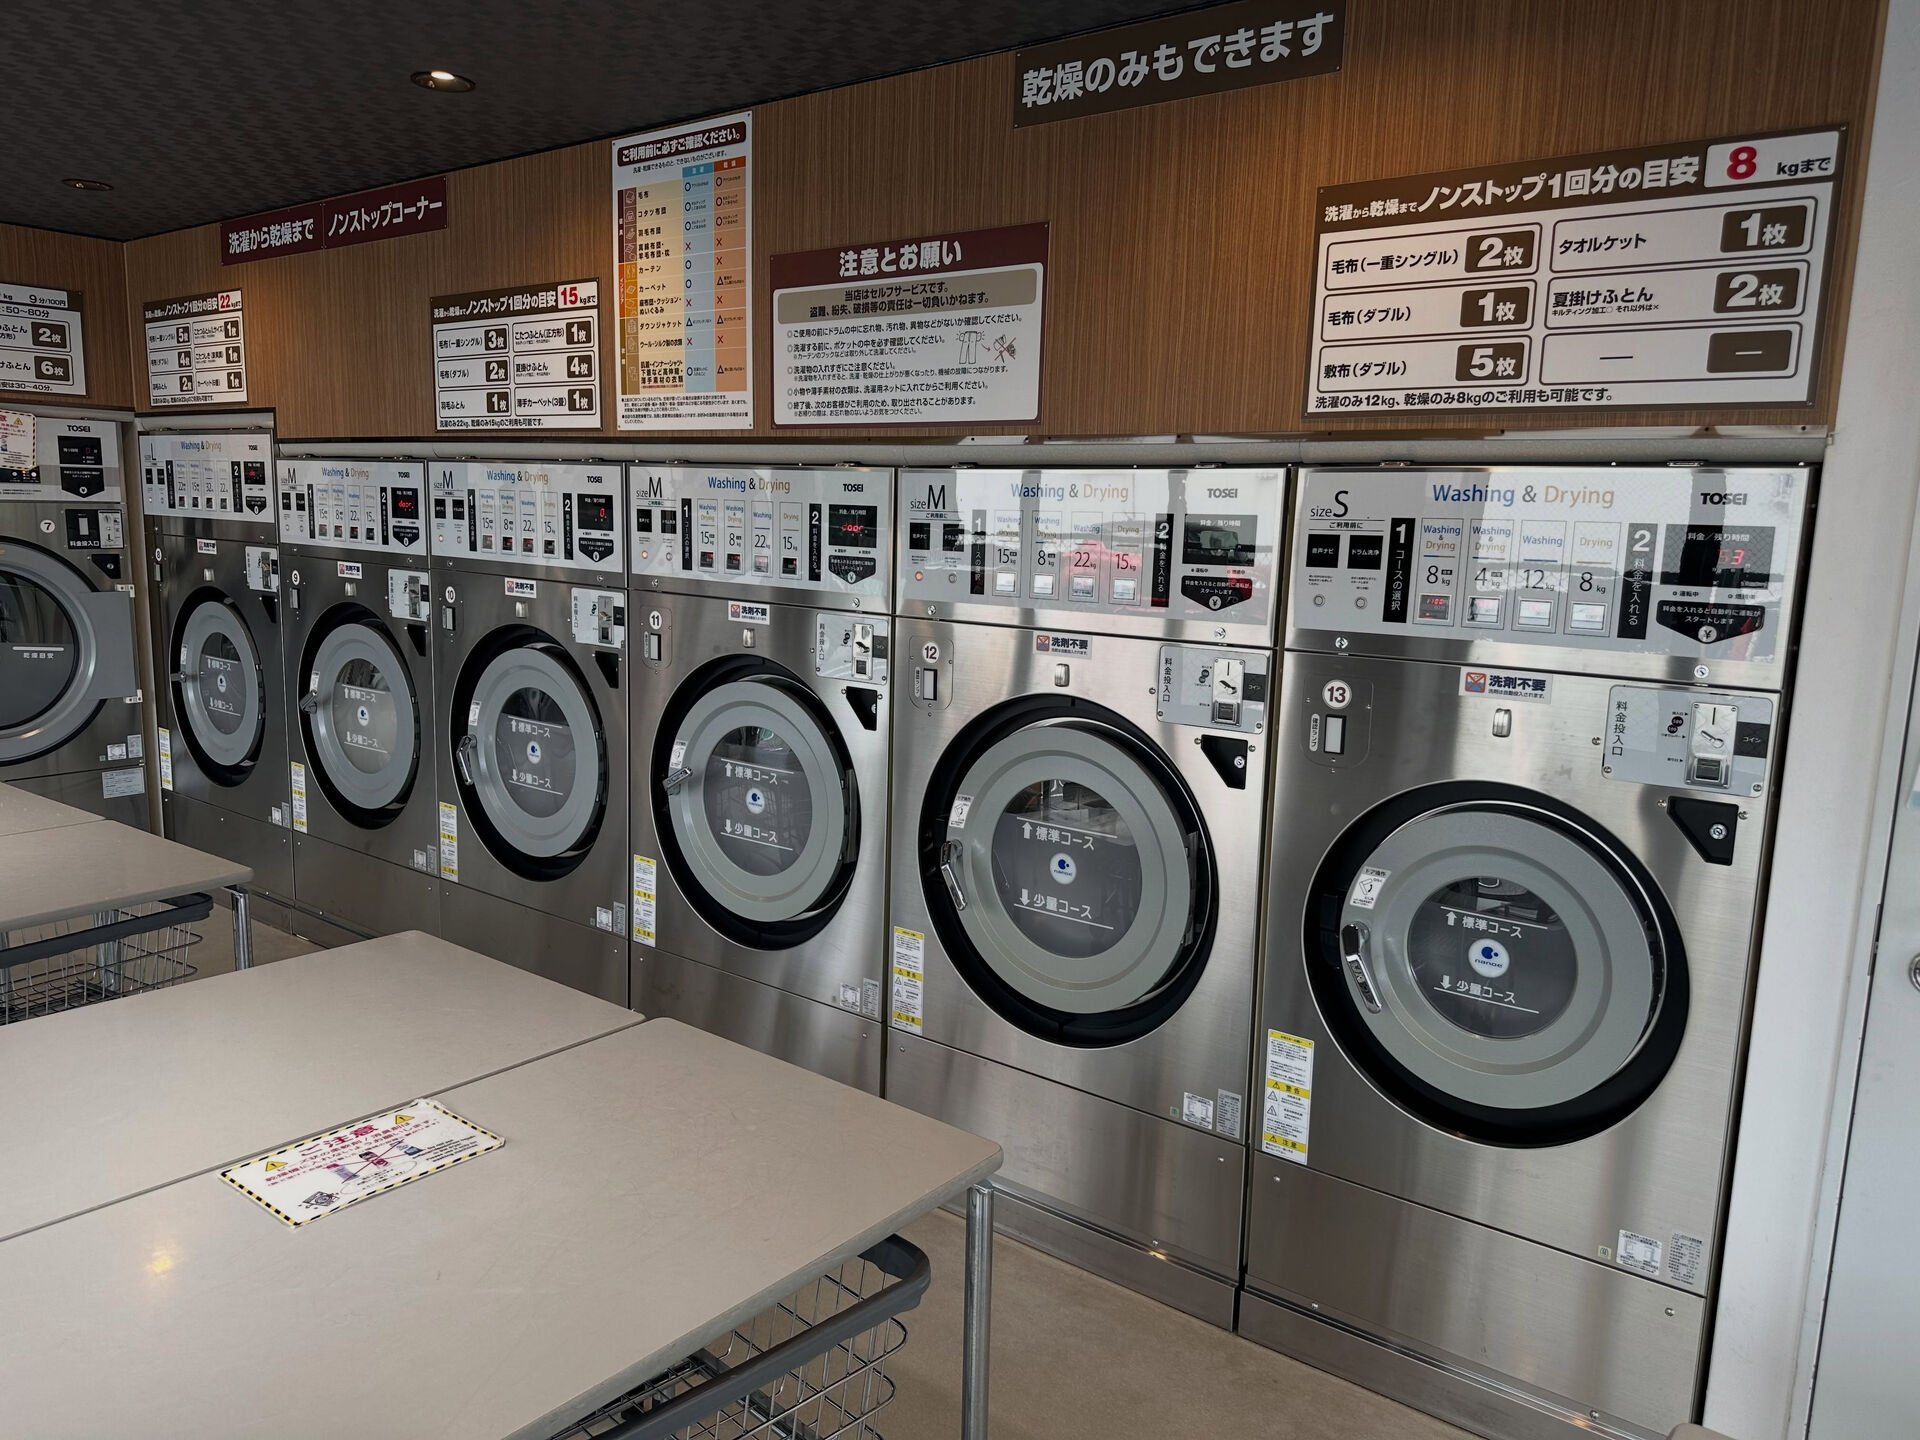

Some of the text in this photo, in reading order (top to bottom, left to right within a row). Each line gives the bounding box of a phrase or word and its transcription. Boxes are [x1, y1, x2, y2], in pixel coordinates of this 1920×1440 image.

[1022, 12, 1334, 108] 乾燥のみもできます
[622, 128, 740, 161] ご利用前に必ずご確認ください。
[1726, 145, 1757, 180] 8
[1776, 156, 1832, 177] kgまで
[638, 190, 649, 199] 毛布
[638, 207, 666, 218] コタツ布団
[229, 196, 442, 254] 洗濯から乾燥まで ノンストップコーナー
[1331, 213, 1787, 274] 毛布(一重シングル) 2枚 タオルケット 1枚
[839, 241, 962, 277] 注意とお願い
[639, 265, 661, 274] カーテン
[639, 283, 666, 292] カーペット
[845, 282, 948, 301] 当店はセルフサービスです。
[220, 294, 231, 309] 22
[561, 287, 578, 305] 15
[579, 295, 596, 304] kgまで
[1327, 273, 1783, 327] 毛布(ダブル) 1枚 夏掛けふとん 2枚
[640, 307, 665, 315] ぬいぐるみ
[810, 292, 989, 318] 盗難、紛失、破損等の責任は一切負いかねます。
[227, 322, 237, 337] 1枚
[640, 321, 682, 330] ダウンジャケット
[38, 327, 61, 343] 2枚
[488, 331, 505, 349] 3枚
[571, 324, 586, 341] 1枚
[180, 353, 190, 366] 4枚
[229, 348, 238, 362] 1枚
[1323, 347, 1516, 379] 敷布(ダブル) 5枚
[41, 361, 64, 376] 6枚
[440, 370, 470, 379] 毛布(ダブル)
[490, 363, 506, 380] 2枚
[570, 357, 589, 375] 4枚
[793, 362, 895, 374] 洗濯物の入れすぎにご注意ください。
[230, 373, 240, 388] 1枚
[441, 401, 465, 410] 羽毛ふとん
[492, 394, 507, 411] 1枚
[573, 391, 589, 409] 1枚
[1315, 387, 1613, 409] 洗濯のみ12kg、乾燥のみ8kgのご利用も可能です。
[181, 441, 221, 452] Washing & Drying
[234, 466, 239, 476] 2
[288, 467, 297, 484] M
[322, 467, 369, 479] Washing & Drying
[487, 470, 549, 485] Washing & Drying
[442, 470, 453, 489] M
[587, 476, 602, 484] TOSEI
[708, 477, 790, 494] Washing & Drying
[648, 477, 662, 498] M
[843, 484, 864, 492] TOSEI
[1010, 483, 1129, 503] Washing & Drying
[1207, 488, 1238, 499] TOSEI
[381, 492, 386, 503] 2
[469, 495, 473, 506] 1
[910, 485, 946, 510] size M
[1433, 484, 1615, 508] Washing & Drying
[1701, 492, 1747, 506] TOSEI
[565, 500, 571, 511] 2
[684, 505, 688, 518] 1
[1310, 490, 1349, 518] size S
[335, 510, 339, 520] 8
[350, 510, 357, 521] 22
[366, 511, 372, 522] 15
[812, 511, 819, 525] 2
[44, 522, 52, 530] 7
[482, 518, 490, 529] 15
[503, 519, 509, 531] 8
[523, 520, 532, 532] 22
[544, 521, 552, 533] 15
[1158, 522, 1170, 539] 2
[1424, 525, 1460, 536] Washing
[1473, 526, 1511, 537] Washing
[754, 535, 766, 548] 22
[783, 536, 792, 550] 15
[1426, 541, 1456, 551] Drying
[1523, 535, 1563, 548] Washing
[1580, 536, 1613, 550] Drying
[997, 548, 1009, 564] 15
[1037, 550, 1045, 565] 8
[1312, 547, 1334, 555] 音声ナビ
[1074, 551, 1090, 568] 22
[1115, 553, 1129, 570] 15
[1391, 523, 1406, 611] 1 コースの選択
[293, 573, 298, 582] 9
[1426, 565, 1438, 584] 8
[1474, 567, 1488, 586] 4
[1523, 569, 1545, 589] 12
[1580, 571, 1593, 592] 8
[1628, 530, 1651, 626] 2 料金を入れる
[447, 589, 454, 600] 10
[1663, 605, 1761, 617] 料金を入れると自動的に運転が
[651, 614, 660, 626] 11
[1685, 615, 1734, 625] スタートします
[1051, 637, 1088, 650] 洗剤不要
[924, 646, 937, 659] 12
[1162, 657, 1172, 702] 料金投入口
[1489, 675, 1546, 692] 洗剤不要
[1327, 686, 1346, 703] 13
[1612, 701, 1627, 756] 料金投入口
[1742, 736, 1761, 744] コイン
[735, 766, 778, 785] 標準コース
[734, 822, 777, 843] 少量コース
[1036, 826, 1094, 850] 標準コース
[1033, 894, 1092, 919] 少量コース
[1462, 915, 1523, 939] 標準コース
[1457, 980, 1516, 1004] 少量コース
[295, 1123, 380, 1158] ご注意
